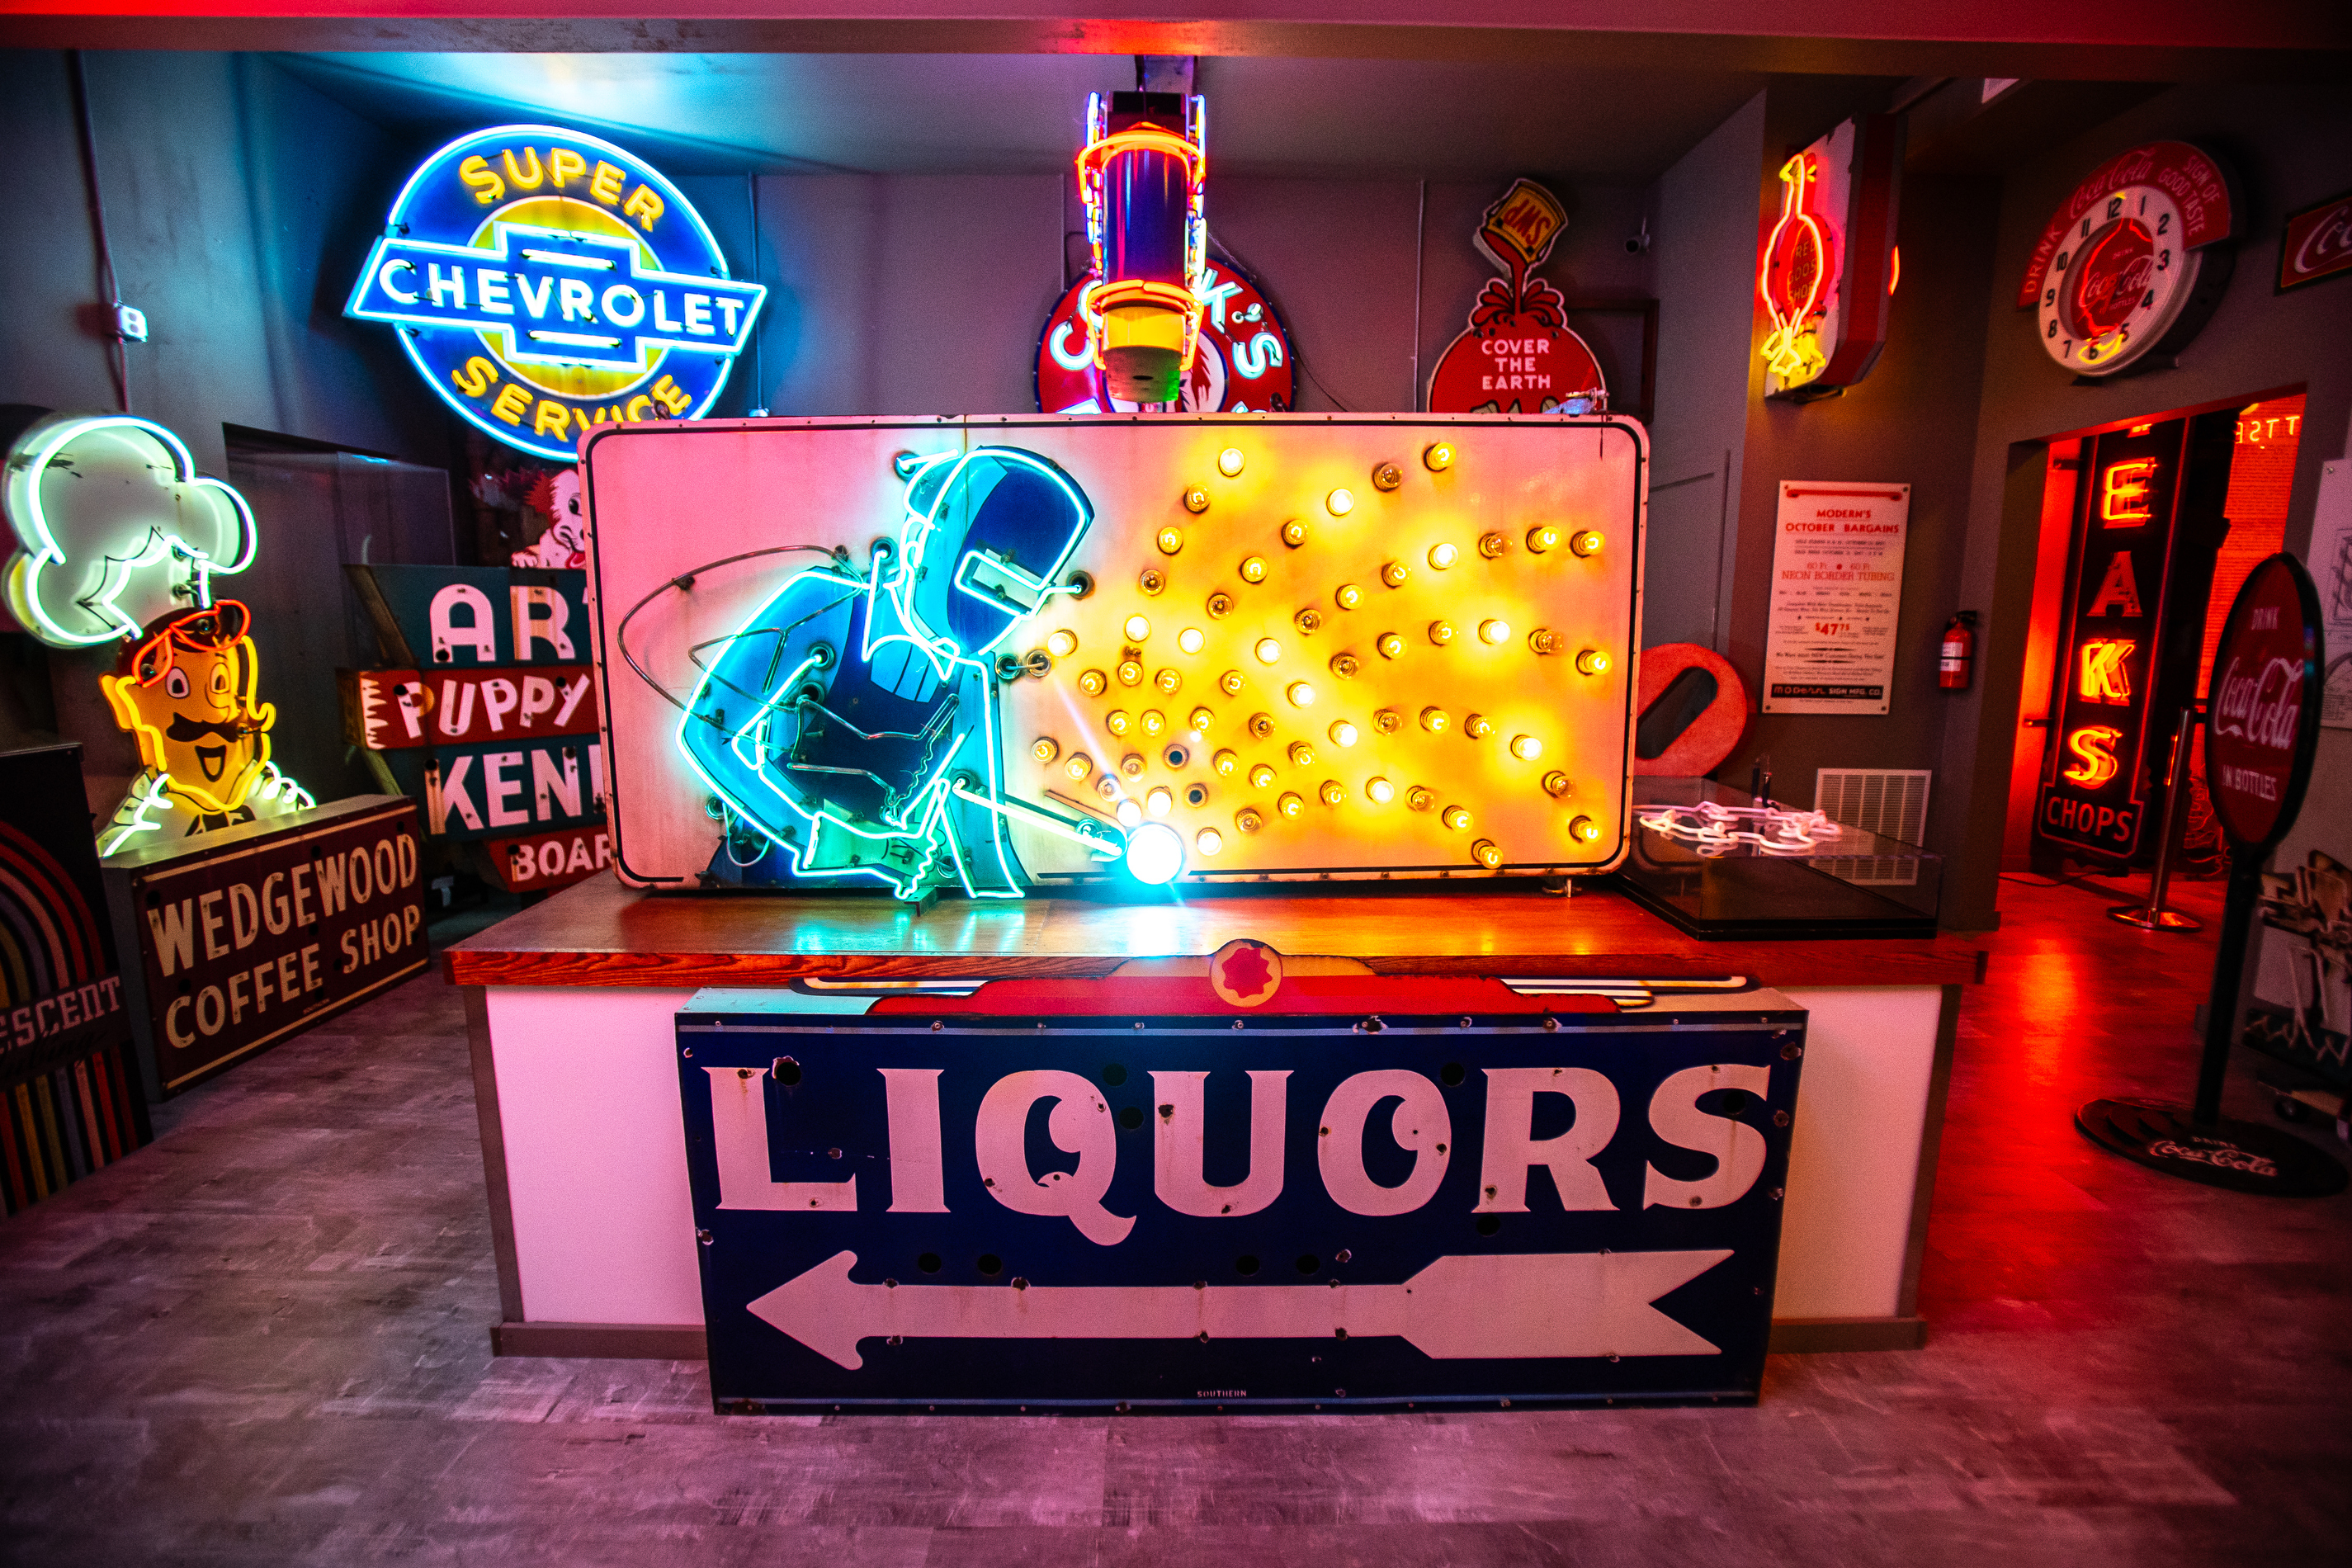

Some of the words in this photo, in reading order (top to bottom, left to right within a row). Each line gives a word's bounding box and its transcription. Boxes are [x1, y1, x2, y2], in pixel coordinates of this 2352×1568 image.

[459, 145, 665, 231] SUPER
[2183, 155, 2212, 187] SIGN
[2203, 183, 2221, 204] OF
[2107, 197, 2123, 220] 12
[2140, 195, 2147, 216] 1
[2158, 168, 2191, 196] GOOD
[2183, 190, 2205, 236] TASTE
[1503, 199, 1551, 245] SWP
[2081, 218, 2091, 239] 11
[2157, 213, 2170, 236] 2
[2024, 224, 2062, 293] DRINK
[2057, 251, 2068, 272] 10
[2157, 248, 2170, 271] 3
[378, 258, 745, 337] CHEVROLET
[2046, 289, 2056, 307] 9
[2141, 289, 2155, 309] 4
[2047, 319, 2058, 338] 8
[1481, 339, 1550, 355] COVER
[2063, 339, 2072, 359] 7
[2089, 341, 2099, 360] 6
[1495, 357, 1536, 372] THE
[1482, 375, 1551, 390] EARTH
[1816, 509, 1872, 519] MODERN'S
[1785, 522, 1835, 532] OCTOBER
[1844, 523, 1899, 534] BARGAINS
[1782, 570, 1811, 580] NEON
[1814, 571, 1854, 581] BORDER
[1858, 572, 1895, 582] TUBING
[2063, 423, 2157, 790] EAKS
[429, 583, 588, 664] AR
[1829, 687, 1848, 696] SIGN
[396, 673, 591, 739] PUPPY
[2047, 796, 2133, 842] CHOPS
[147, 834, 418, 976] WEDGEWOOD
[166, 942, 324, 1048] COFFEE
[341, 904, 422, 974] SHOP
[699, 1064, 1773, 1247] LIQUORS
[1197, 1390, 1247, 1398] SOUTHERN
